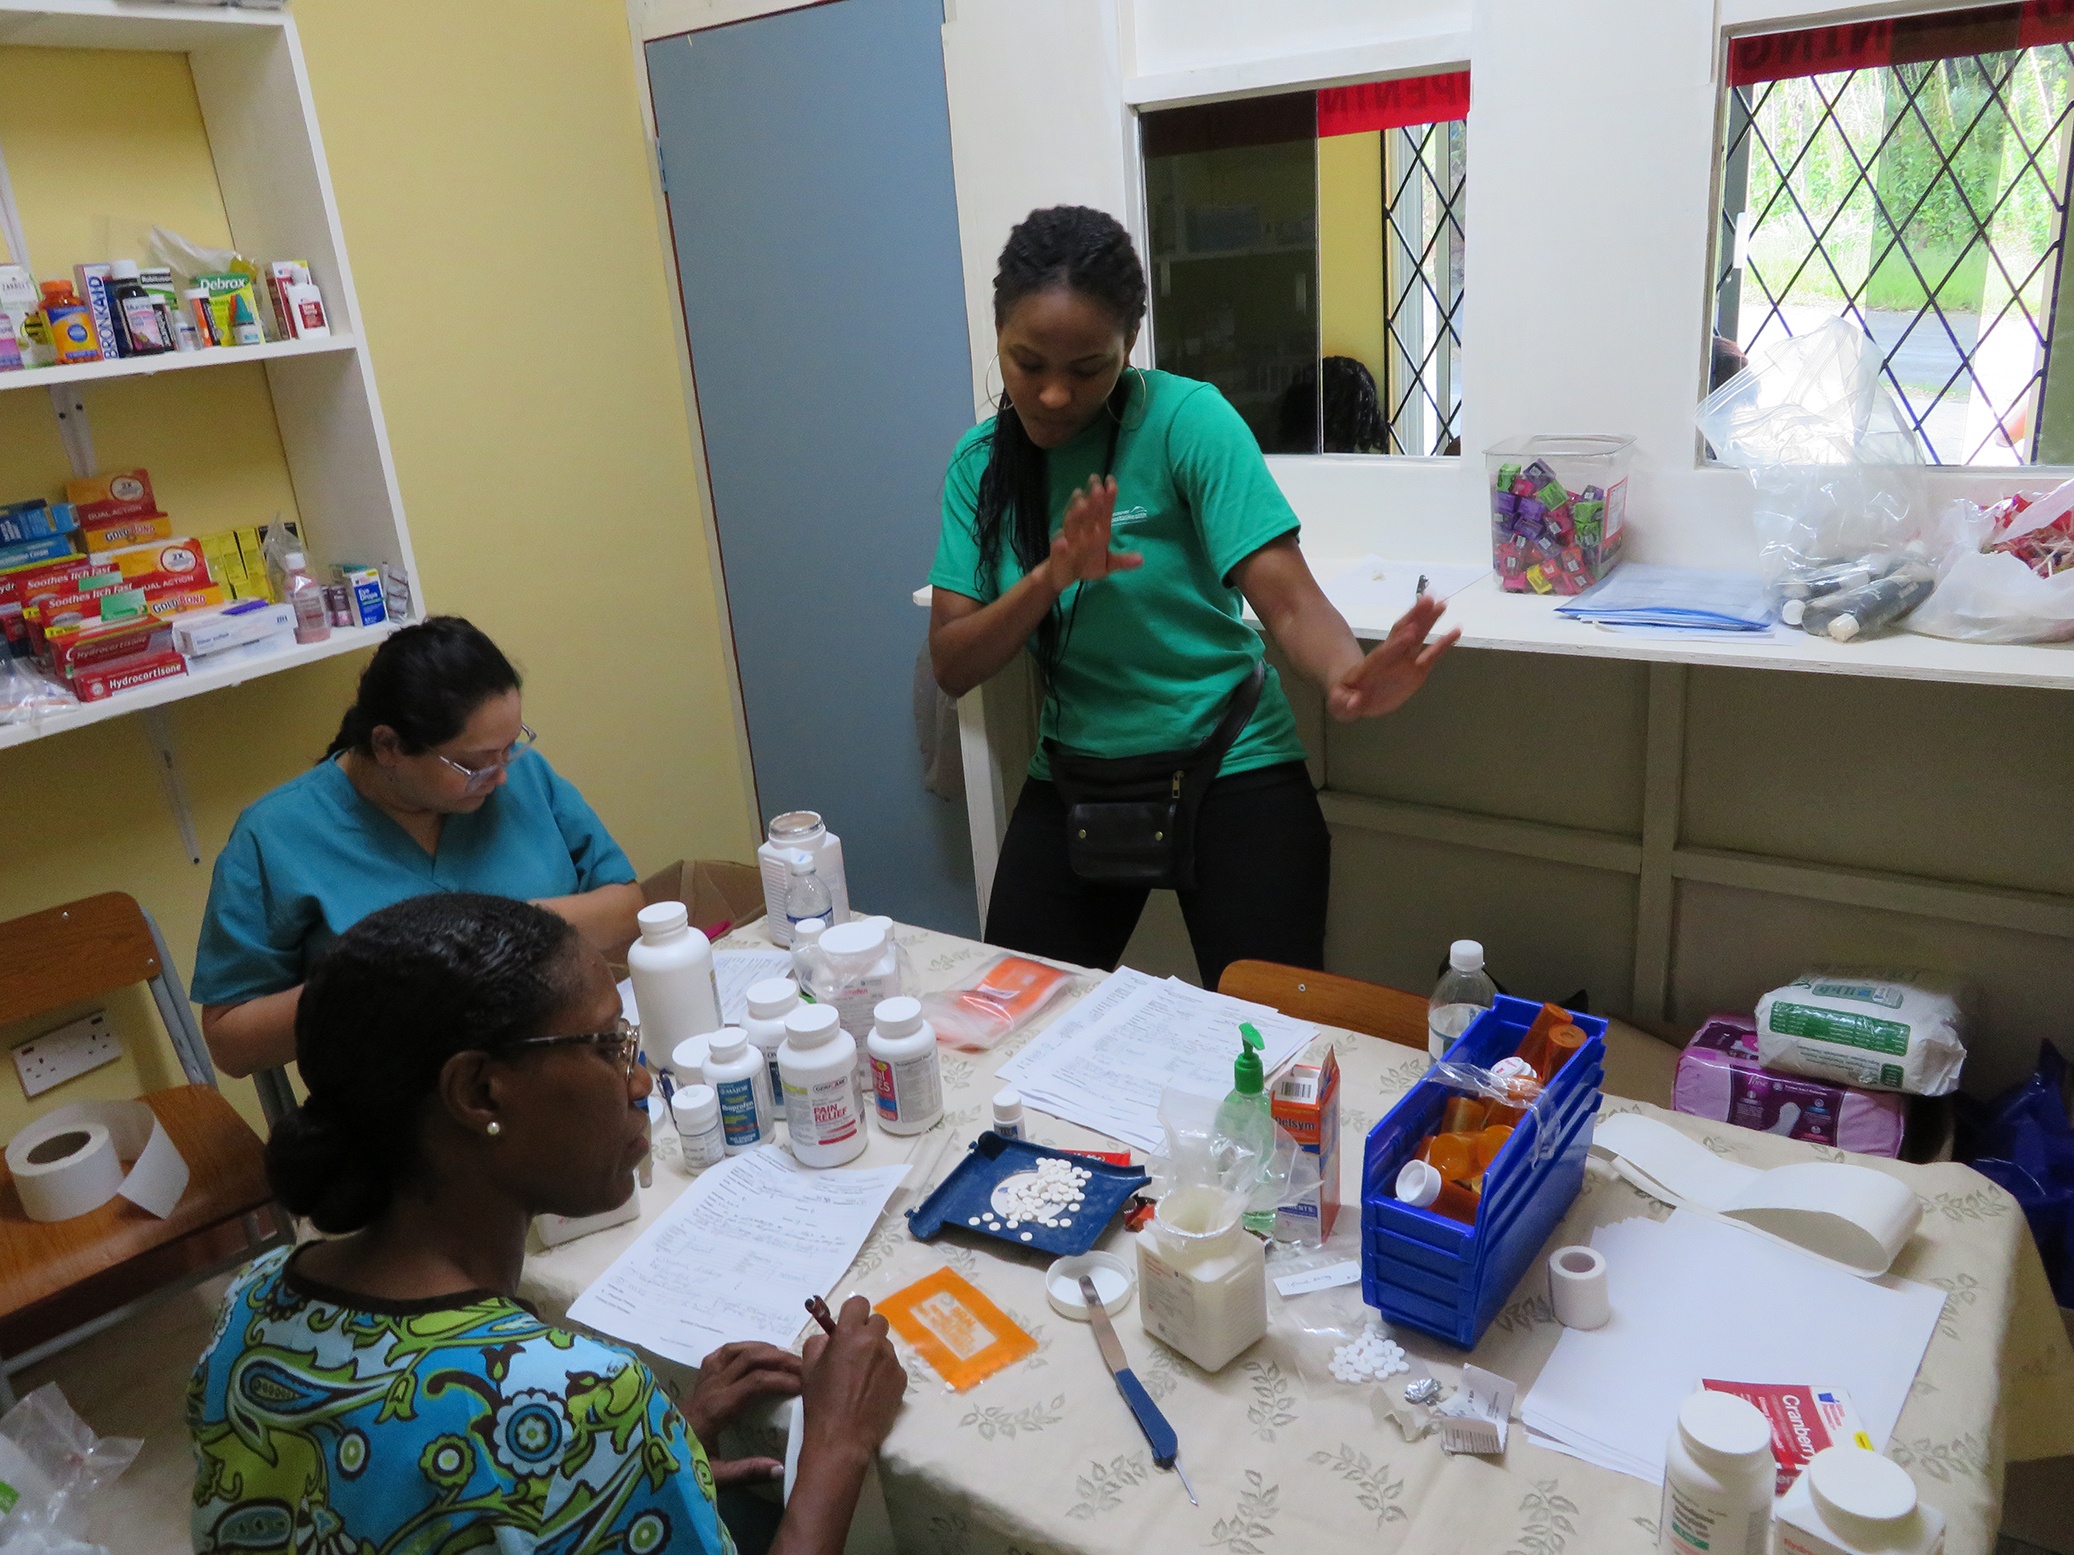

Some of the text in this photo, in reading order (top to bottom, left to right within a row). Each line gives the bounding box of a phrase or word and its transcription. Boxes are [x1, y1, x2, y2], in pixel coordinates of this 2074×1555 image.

[200, 277, 246, 291] Debrox
[88, 276, 118, 359] BRONKAID
[27, 574, 69, 590] Soothes
[71, 568, 91, 580] Itch
[162, 575, 194, 589] ACTION
[49, 583, 133, 609] Soothes Itch Fast
[109, 664, 182, 689] Hydrocortisone
[813, 1103, 838, 1115] PAIN
[815, 1107, 848, 1123] RELIEF
[1781, 1393, 1818, 1461] Cranberry
